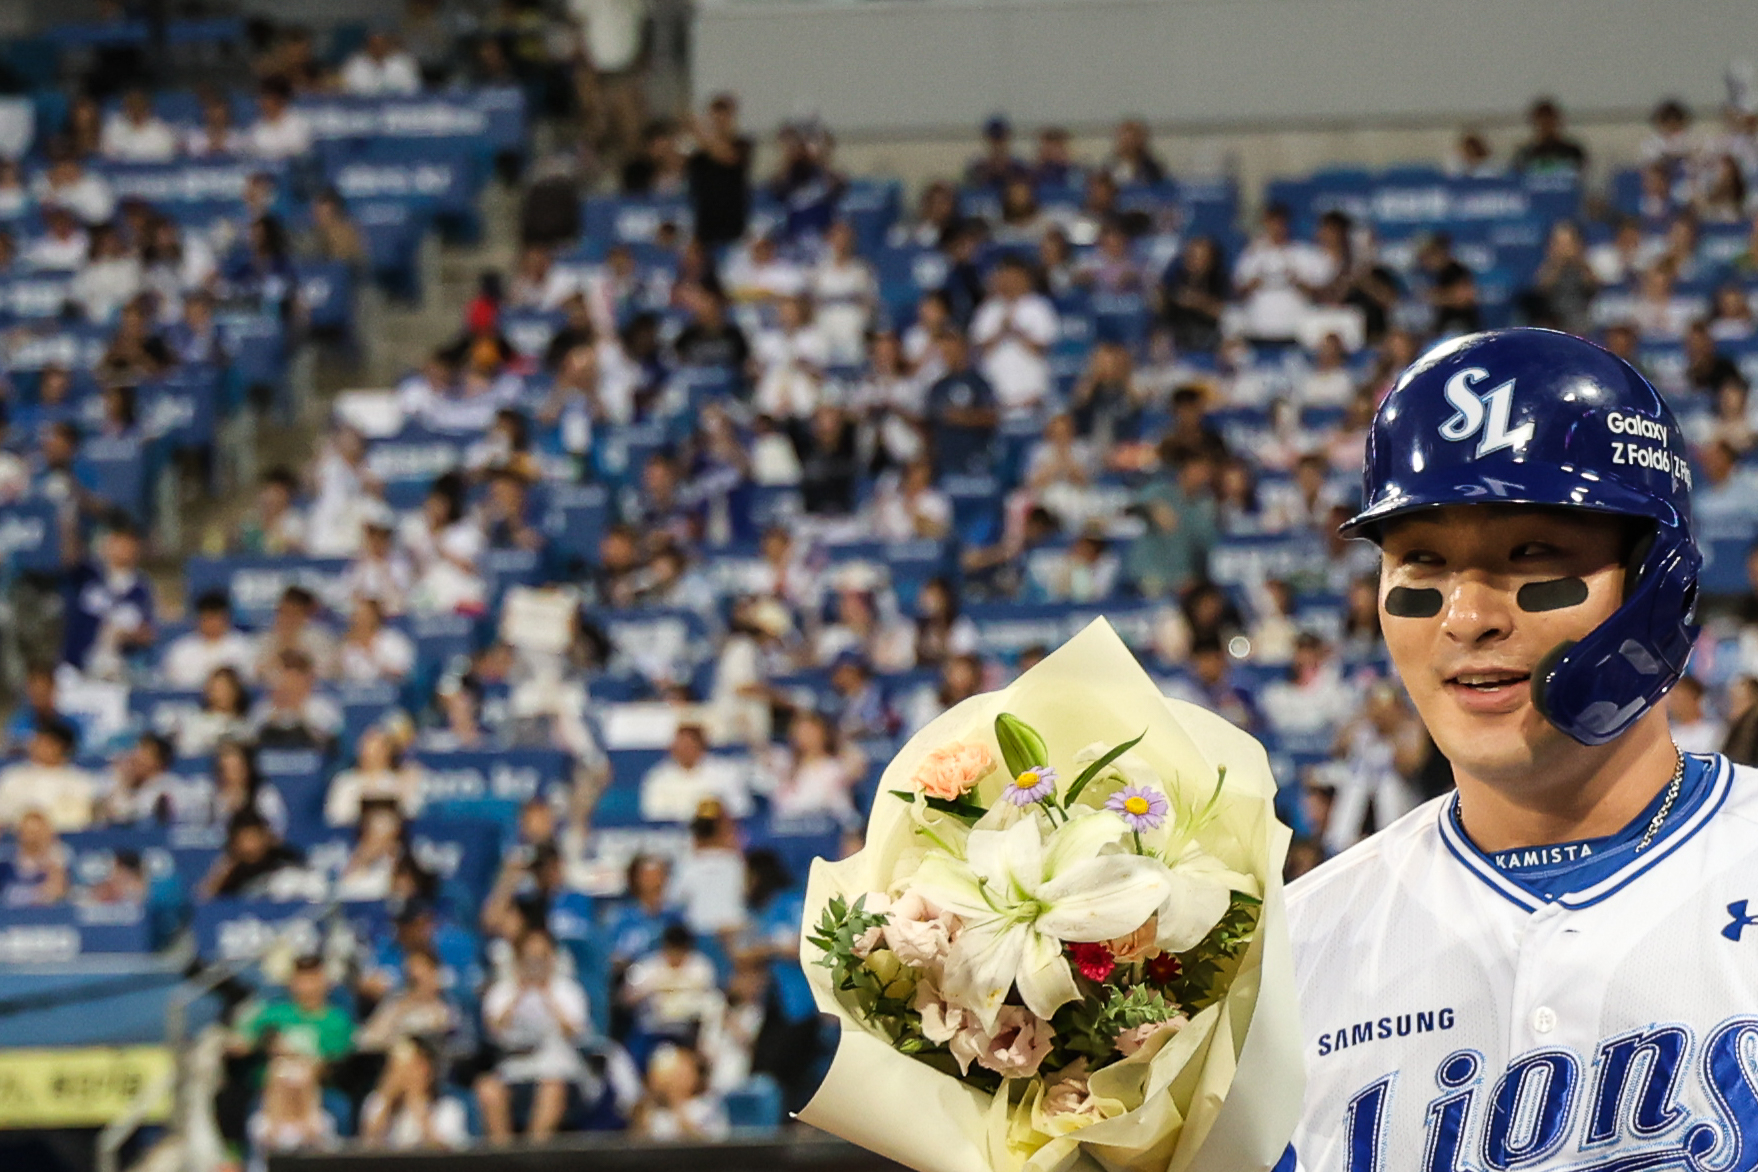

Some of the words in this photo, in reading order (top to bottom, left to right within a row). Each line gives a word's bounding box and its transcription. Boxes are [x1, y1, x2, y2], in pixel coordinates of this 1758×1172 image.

[1438, 367, 1535, 460] SL
[1607, 411, 1668, 449] Galaxy
[1611, 442, 1626, 465] Z
[1627, 443, 1671, 473] Fold6
[1495, 844, 1593, 870] KAMISTA
[1317, 1008, 1456, 1057] SAMSUNG
